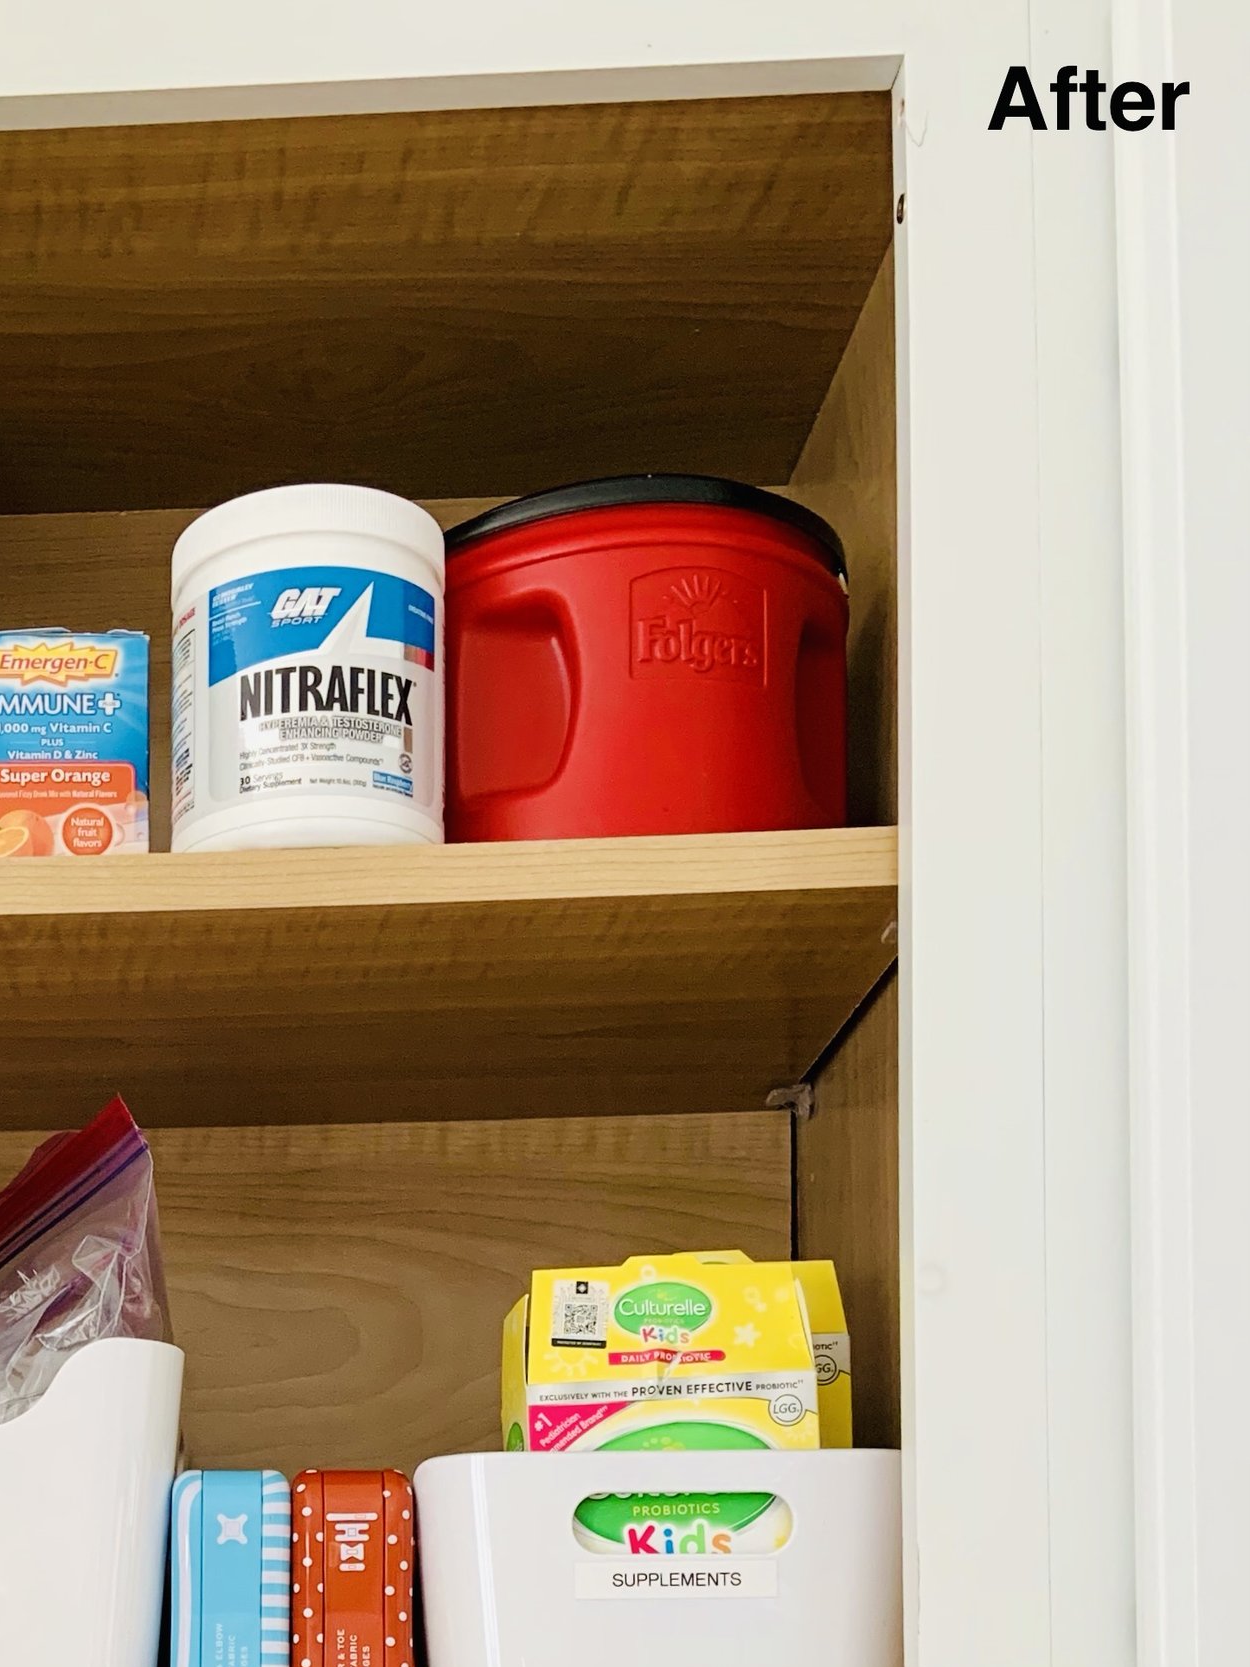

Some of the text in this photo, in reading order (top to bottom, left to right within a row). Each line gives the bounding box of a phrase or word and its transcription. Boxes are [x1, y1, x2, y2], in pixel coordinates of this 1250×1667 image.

[271, 616, 322, 628] SPORT
[638, 615, 759, 673] Folgers
[0, 653, 110, 674] Emergen-C
[240, 665, 412, 726] NITRAFLEX
[31, 726, 47, 736] mg
[50, 722, 100, 733] Vitamin
[103, 723, 112, 733] C
[321, 717, 330, 729] &
[332, 716, 402, 736] TESTOSTERONE
[41, 738, 64, 747] PLUS
[279, 727, 384, 744] ENHANCING POWDER
[310, 742, 336, 752] Strength
[8, 750, 98, 760] Vitamin D & Zinc
[0, 769, 111, 788] Super Orange
[240, 771, 284, 786] 30 Servings
[263, 778, 302, 789] Supplement
[71, 818, 105, 827] Natural
[77, 828, 98, 837] fruit
[73, 838, 102, 848] flavors
[618, 1298, 707, 1316] Culturelle
[642, 1326, 690, 1344] Kids
[621, 1352, 652, 1364] DAILY
[539, 1393, 589, 1402] EXCLUSIVELY
[591, 1392, 612, 1400] WITH
[631, 1384, 683, 1397] PROVEN
[686, 1380, 753, 1396] EFFECTIVE
[539, 1412, 582, 1448] Pediatrician
[633, 1503, 720, 1517] PROBIOTICS
[628, 1523, 732, 1554] Kids
[612, 1572, 742, 1587] SUPPLEMENTS
[337, 1629, 345, 1650] TOE
